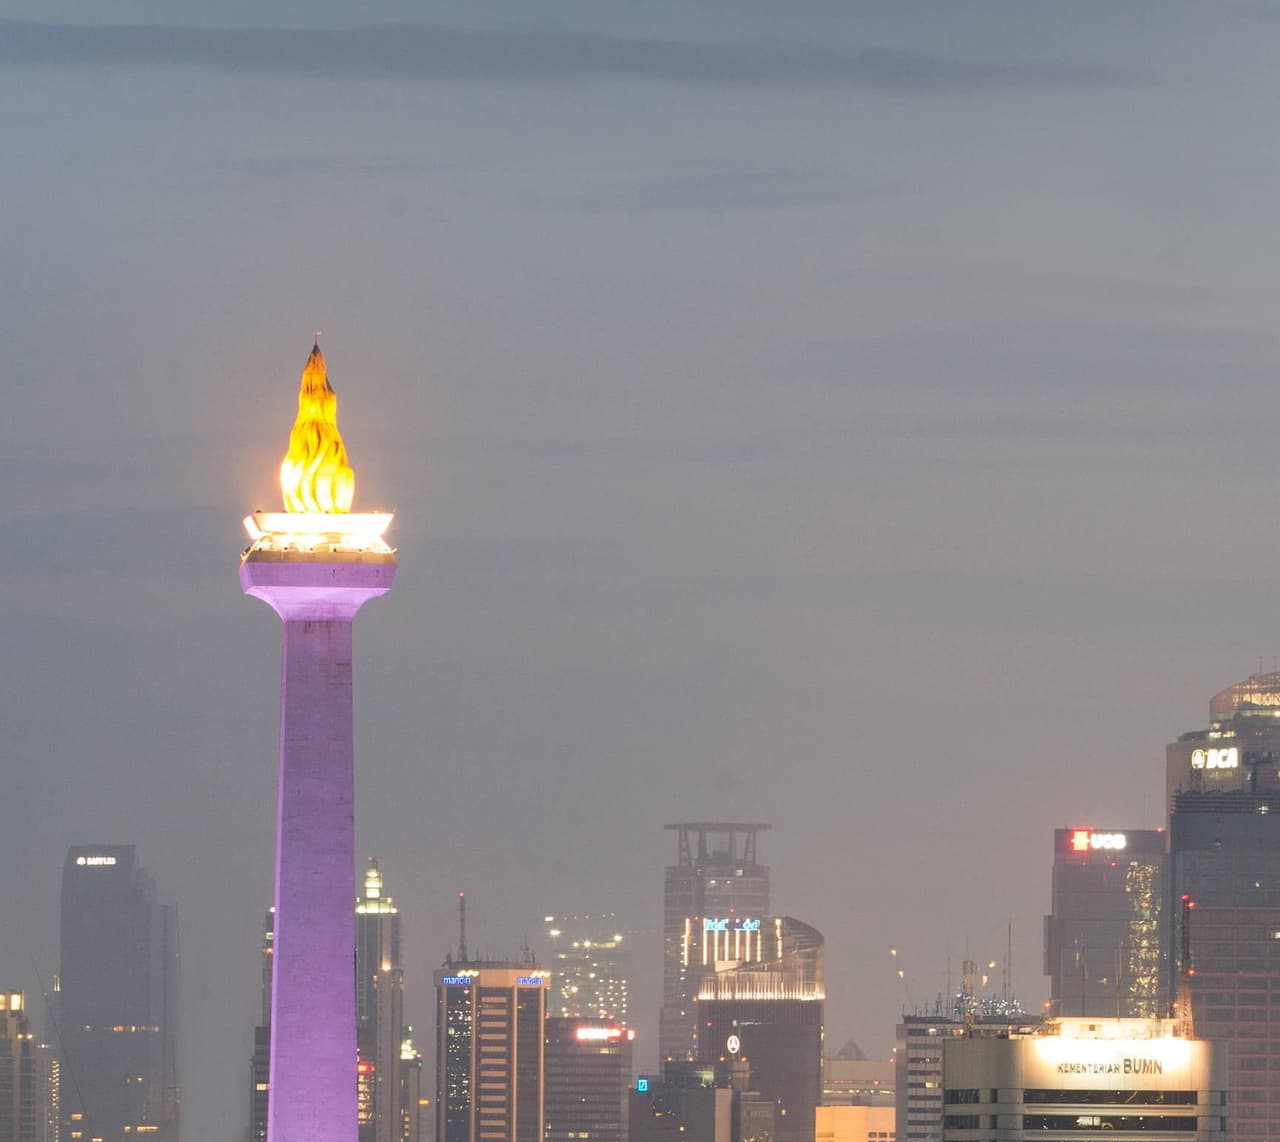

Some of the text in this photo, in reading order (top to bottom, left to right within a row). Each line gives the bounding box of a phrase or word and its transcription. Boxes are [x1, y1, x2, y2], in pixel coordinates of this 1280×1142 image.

[1206, 747, 1238, 769] BCA
[1091, 833, 1126, 850] UOB
[1057, 1058, 1163, 1075] KEMENTERIAN BUMN
